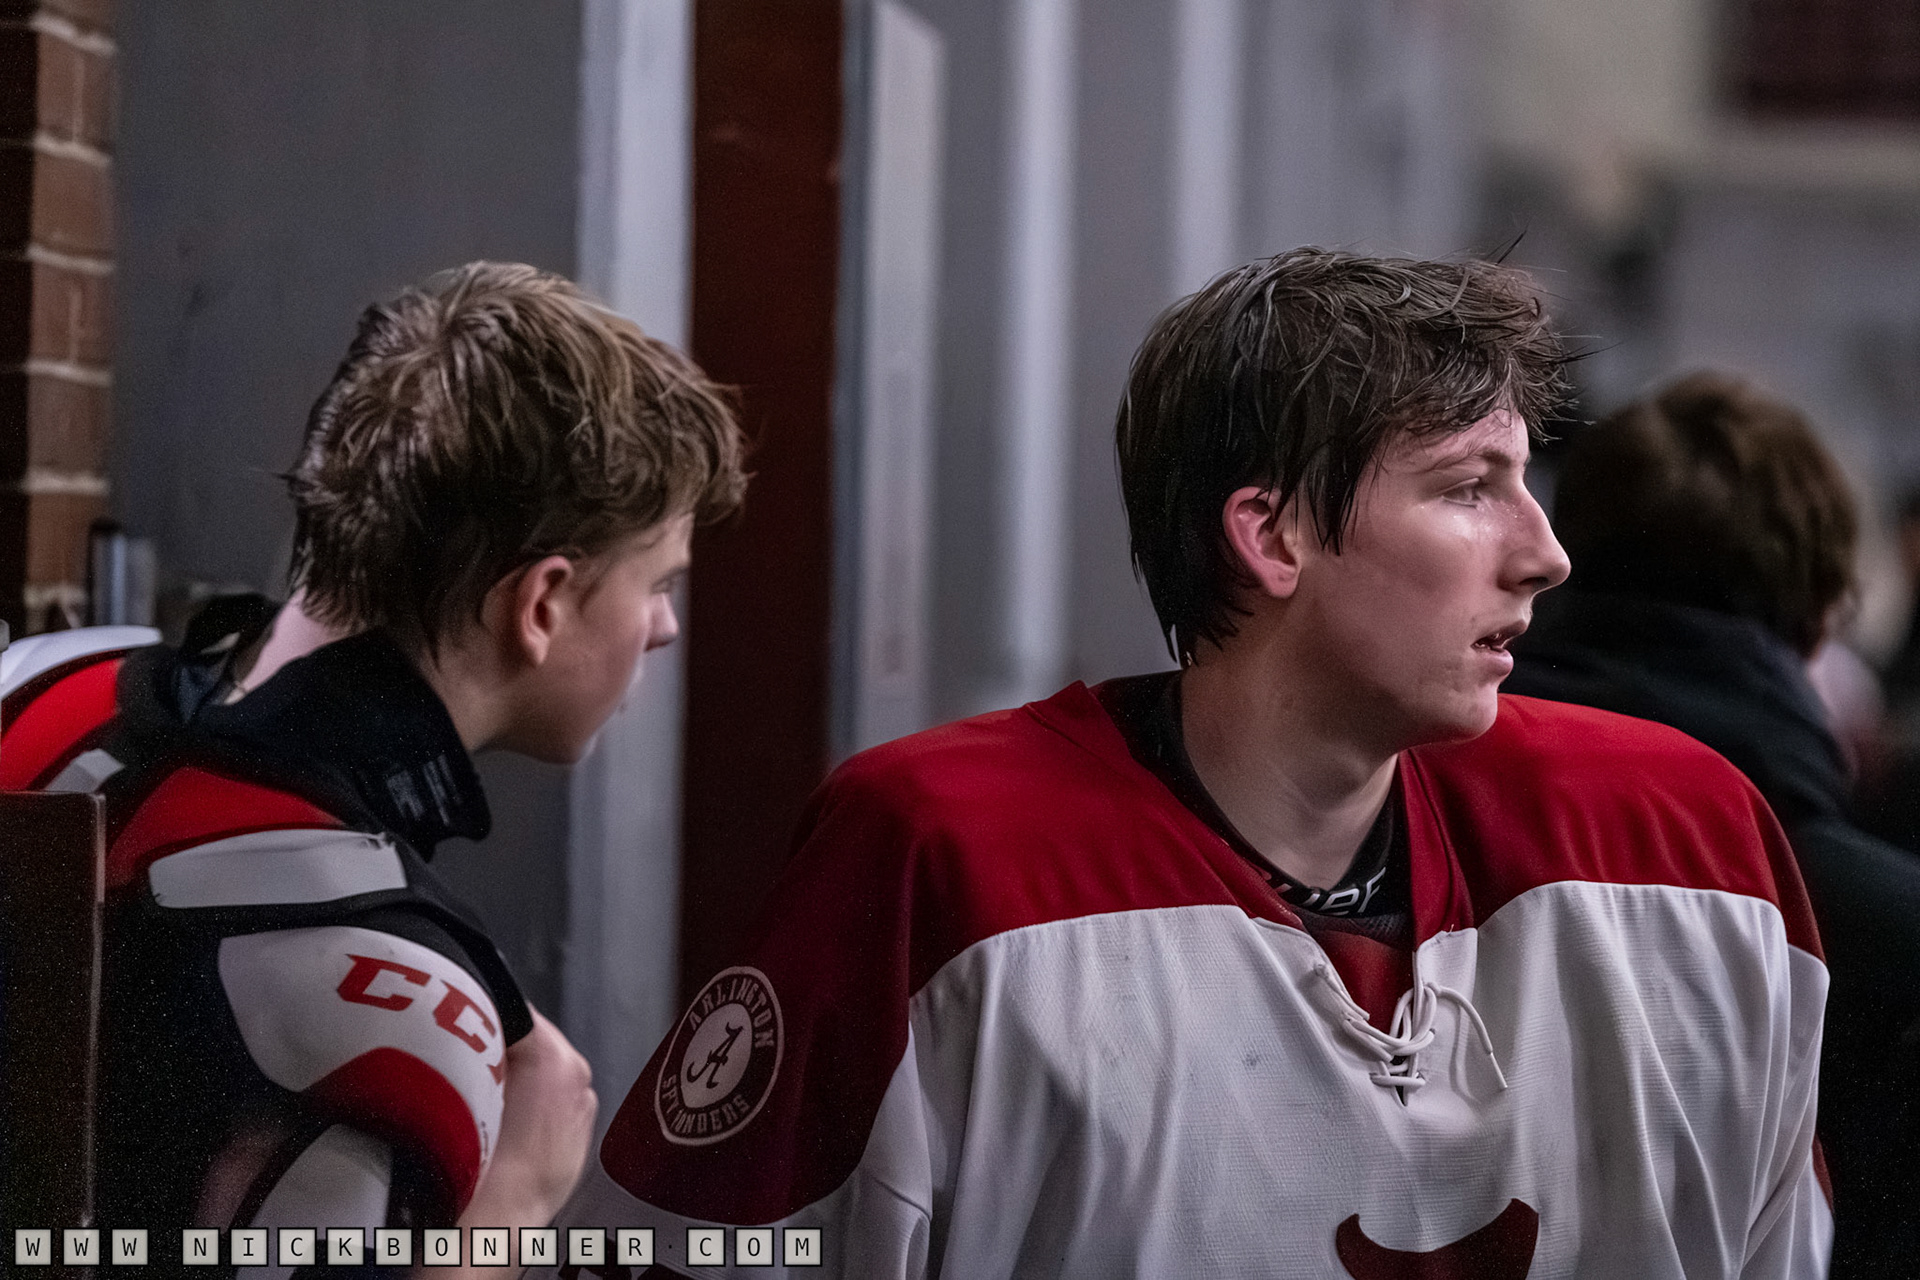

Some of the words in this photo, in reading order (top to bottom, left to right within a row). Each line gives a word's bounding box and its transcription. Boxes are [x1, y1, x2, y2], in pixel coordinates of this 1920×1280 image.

[335, 953, 504, 1086] CC
[687, 976, 775, 1049] ARLINGTON
[686, 1021, 744, 1090] A
